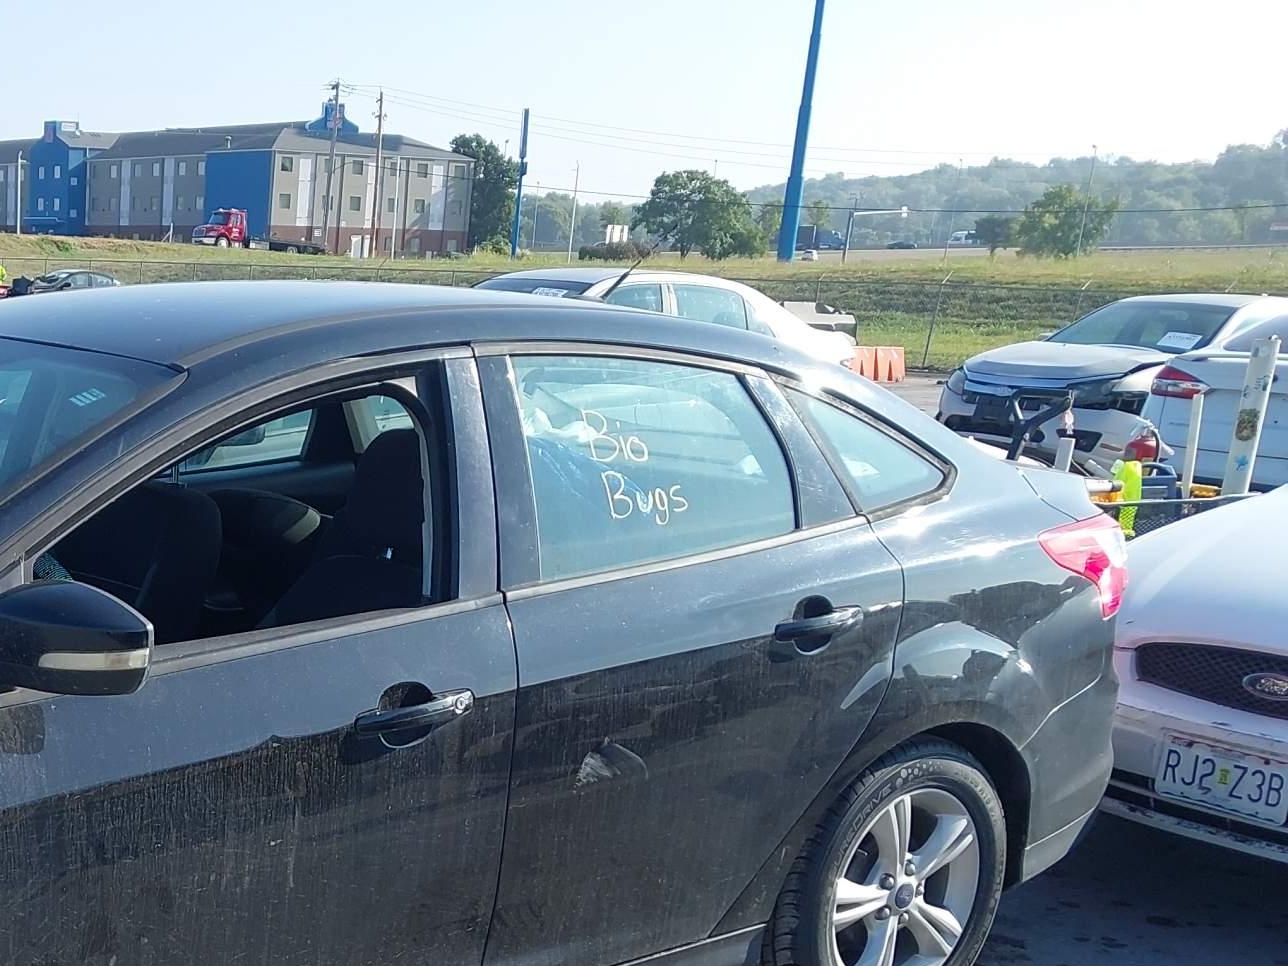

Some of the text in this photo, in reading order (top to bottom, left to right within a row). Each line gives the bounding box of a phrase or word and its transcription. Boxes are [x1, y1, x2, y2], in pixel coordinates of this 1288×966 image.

[580, 408, 649, 462] Bio
[600, 470, 689, 525] Bugs
[1162, 748, 1285, 808] RJ2 Z3B
